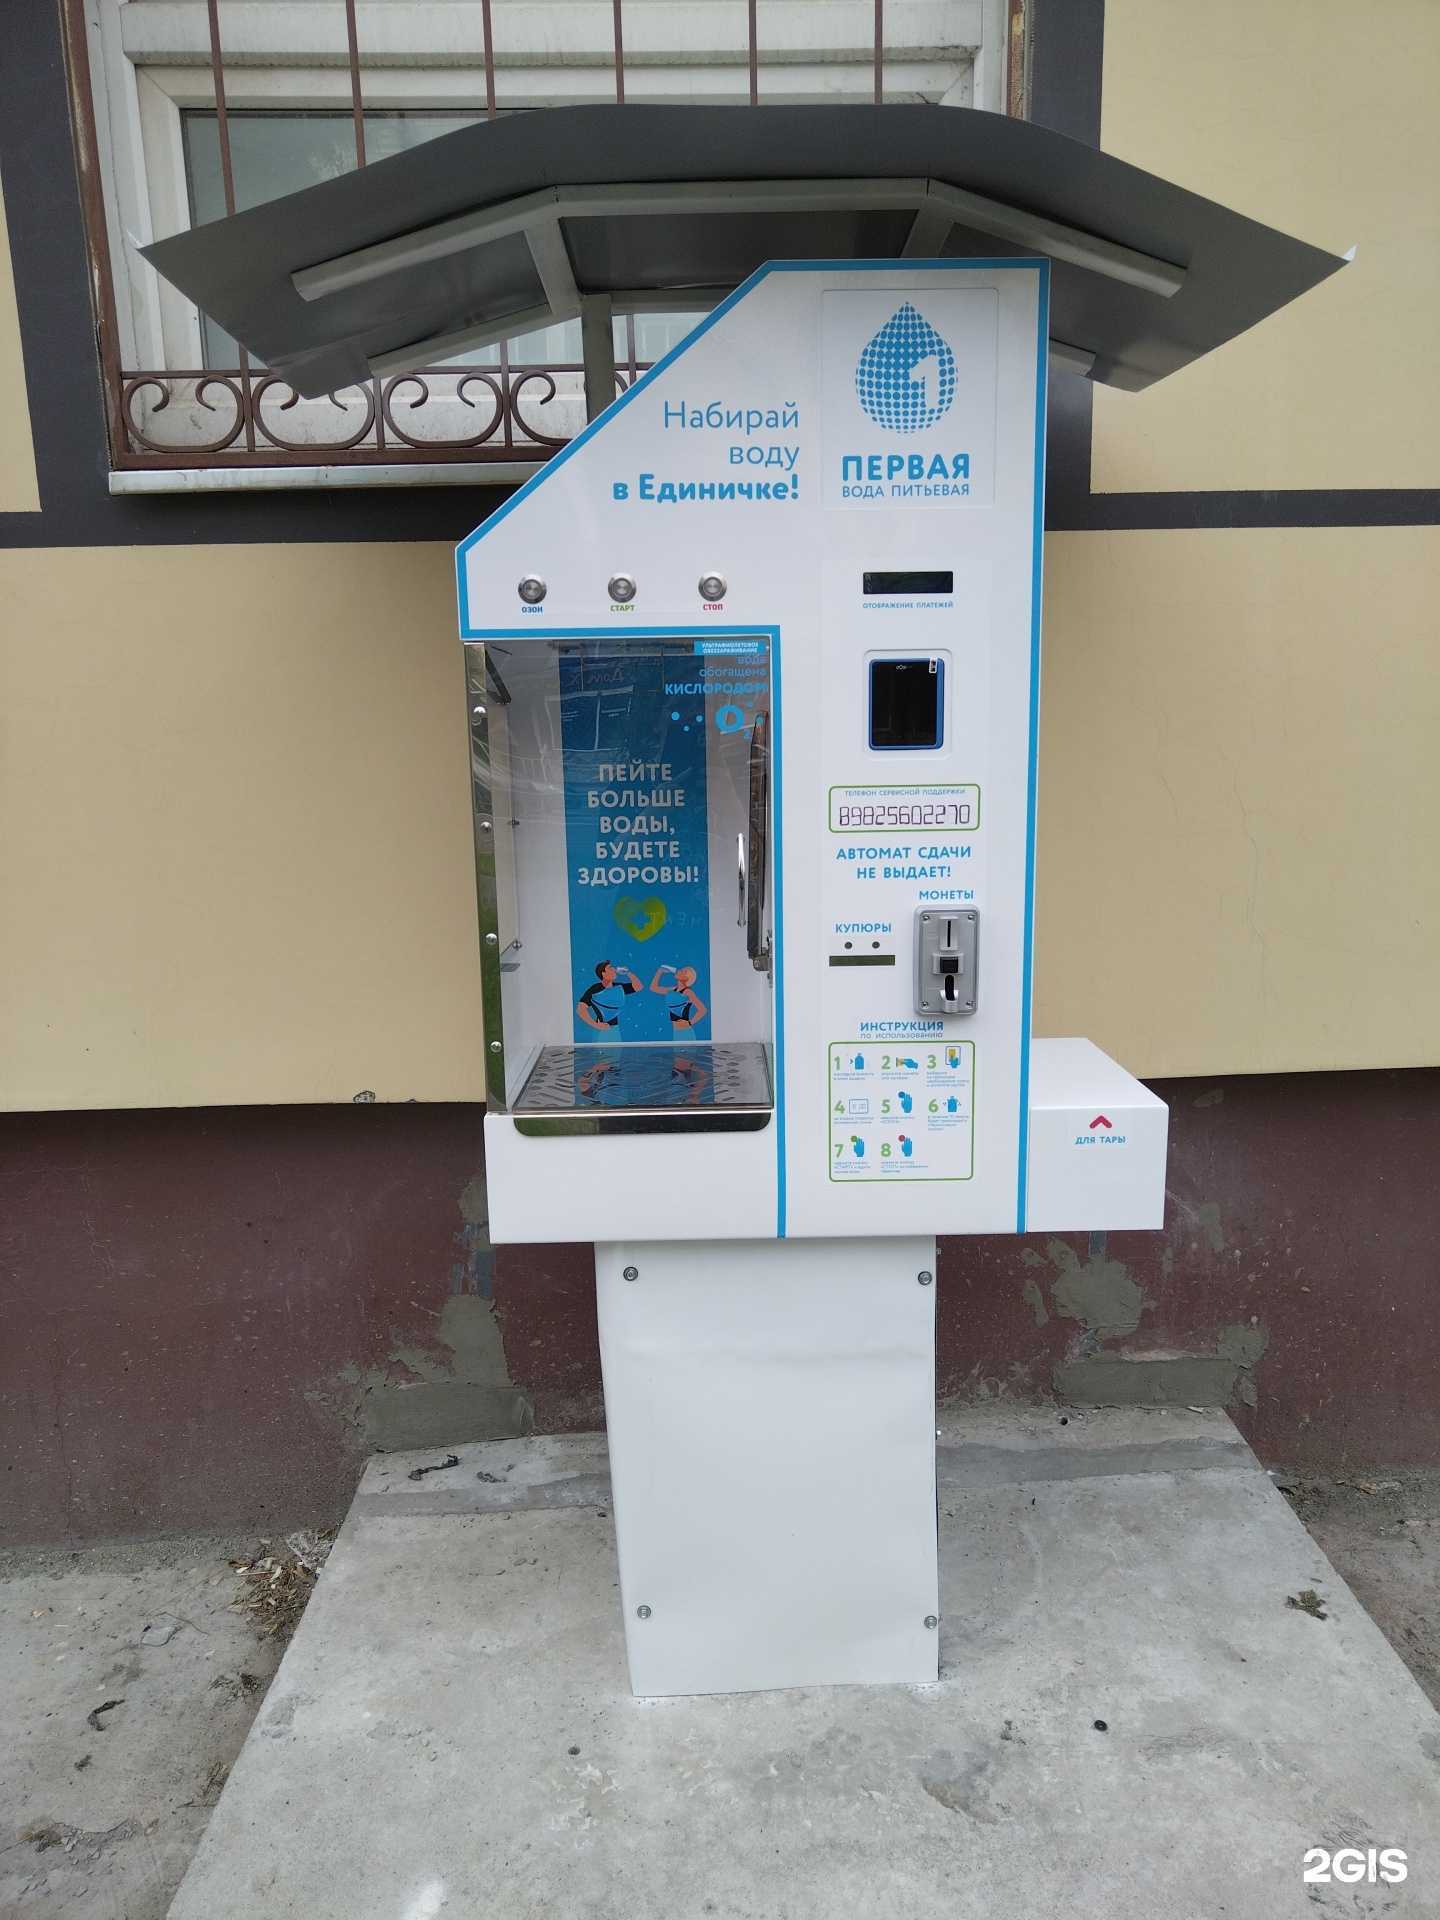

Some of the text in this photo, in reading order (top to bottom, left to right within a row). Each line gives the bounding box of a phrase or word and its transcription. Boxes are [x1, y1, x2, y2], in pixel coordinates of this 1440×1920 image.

[664, 401, 799, 434] Набирай
[730, 445, 800, 470] воду
[842, 453, 970, 481] ПЕРВАЯ
[613, 474, 799, 502] в Единичке!
[842, 483, 970, 499] ВОДА ПИТЬЕВАЯ
[521, 604, 543, 613] ОЗОН
[610, 603, 635, 612] СТАРТ
[702, 602, 724, 611] СТОП
[862, 600, 954, 609] ОТОБРАЖЕНИЕ ПЛАТЕЖЕЙ
[599, 760, 672, 782] ПЕЙТЕ
[587, 789, 685, 808] БОЛЬШЕ
[839, 805, 971, 826] 89825602270
[600, 816, 675, 836] ВОДЫ,
[596, 841, 680, 860] БУДЕТЕ
[836, 846, 971, 860] АВТОМАТ СДАЧИ
[578, 866, 699, 886] ЗДОРОВЫ!
[857, 866, 951, 880] НЕ ВЫДАЕТ!
[919, 890, 974, 900] МОНЕТЫ
[835, 923, 891, 933] КУПЮРЫ
[860, 1021, 944, 1032] ИНСТРУКЦИЯ
[875, 1031, 943, 1039] использованию
[834, 1056, 841, 1071] 1
[881, 1055, 891, 1070] 2
[927, 1055, 937, 1069] 3
[834, 1100, 846, 1114] 4
[881, 1099, 891, 1114] 5
[928, 1098, 939, 1113] 6
[1075, 1136, 1126, 1145] ДЛЯ ТАРЫ
[834, 1144, 844, 1158] 7
[880, 1143, 892, 1157] 8
